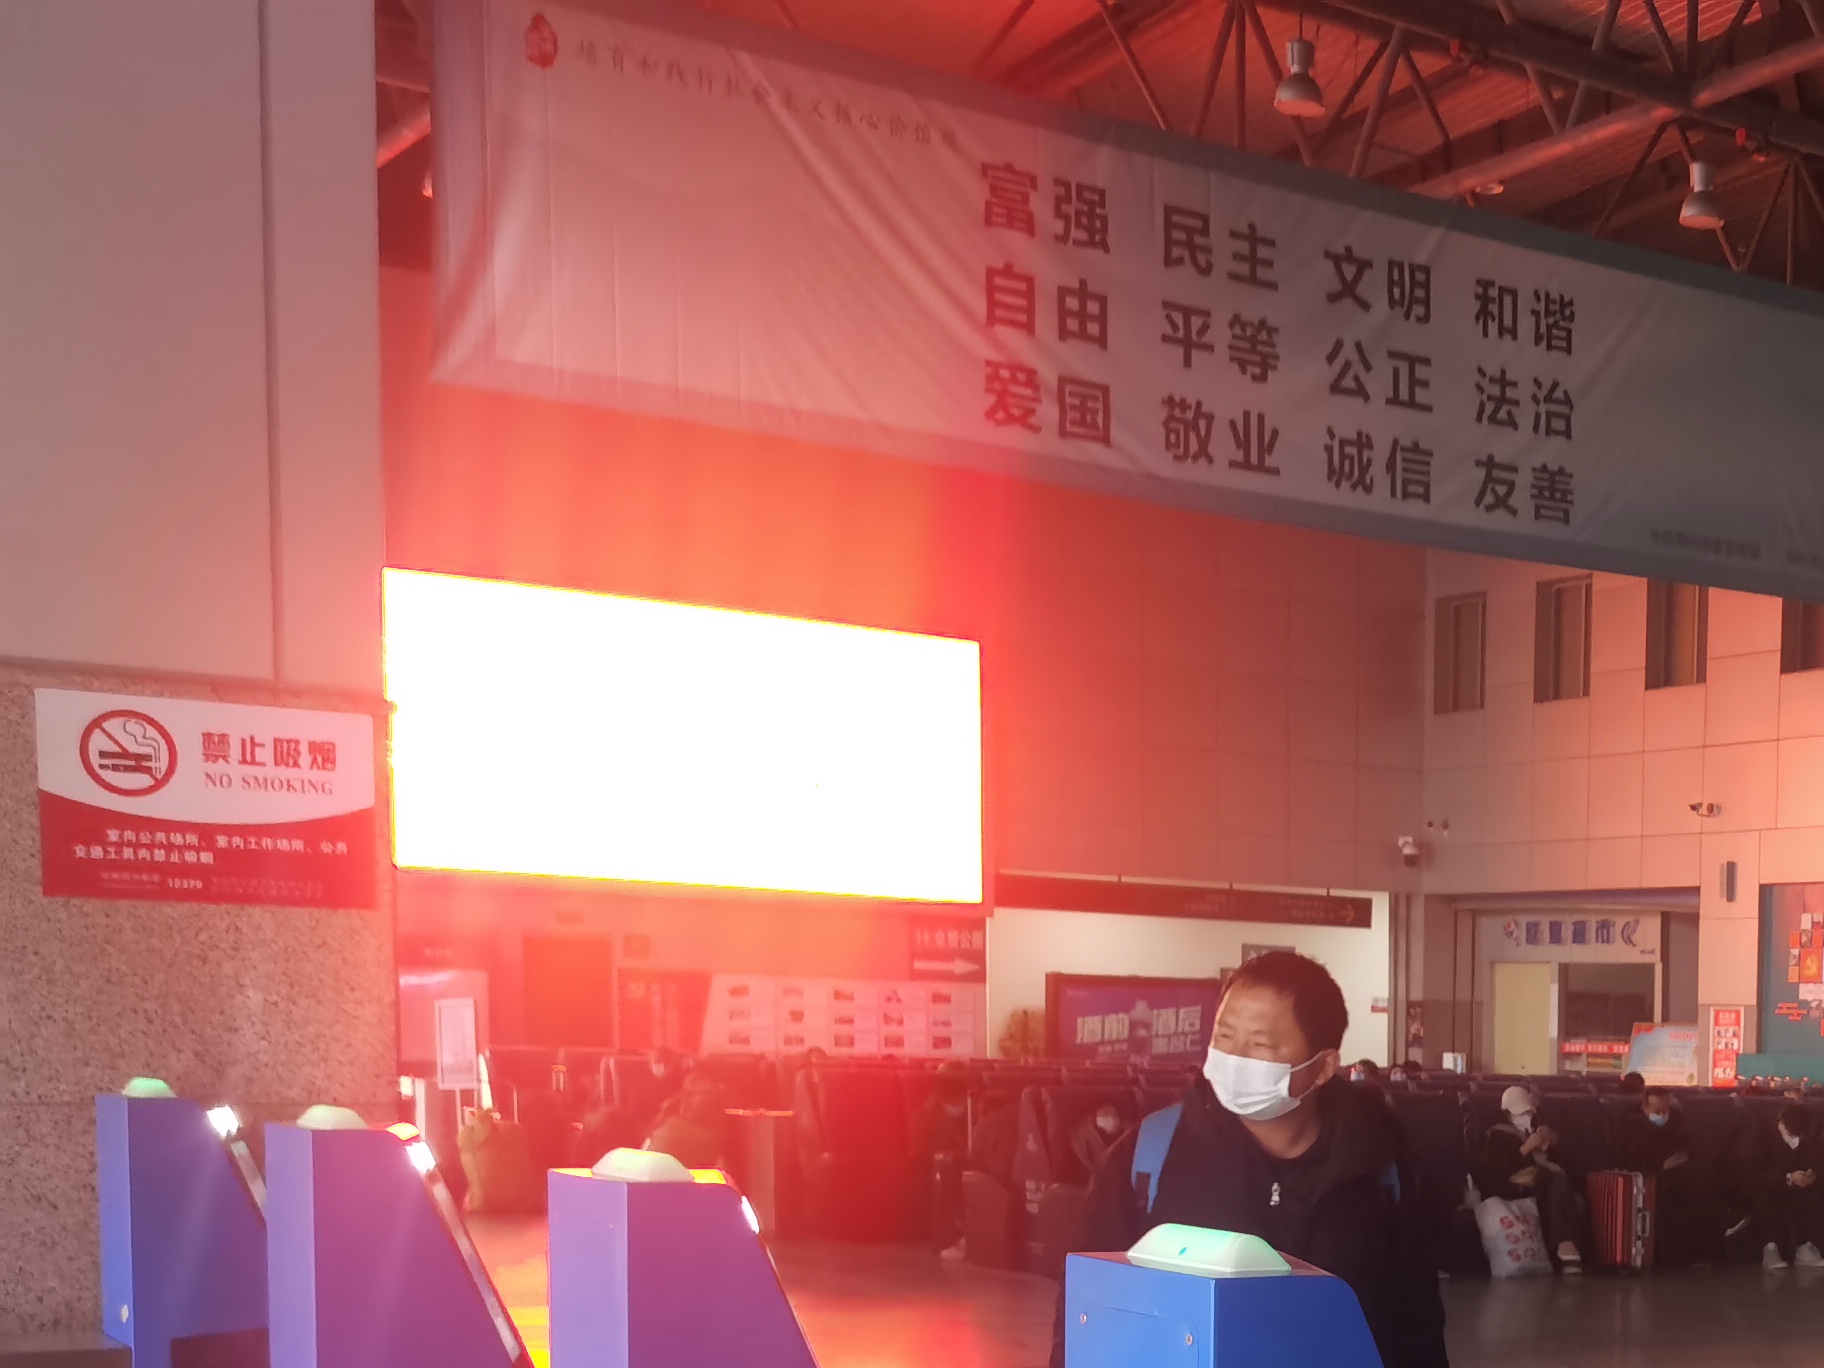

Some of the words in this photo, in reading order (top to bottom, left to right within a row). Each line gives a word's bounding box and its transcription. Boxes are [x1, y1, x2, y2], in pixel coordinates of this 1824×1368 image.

[981, 160, 1111, 256] 富强
[1162, 203, 1280, 294] 民主
[1323, 244, 1433, 326] 文明
[1473, 277, 1577, 358] 和谐
[984, 261, 1110, 353] 自由
[1160, 299, 1281, 386] 平等
[1324, 336, 1434, 414] 公正
[1473, 364, 1577, 443] 法治
[983, 357, 1113, 449] 爱国
[1160, 393, 1281, 479] 敬业
[1322, 424, 1434, 506] 诚信
[1473, 452, 1577, 528] 友善
[201, 731, 337, 773] 禁止吸烟
[204, 771, 233, 789] NO
[241, 775, 334, 796] SMOKING
